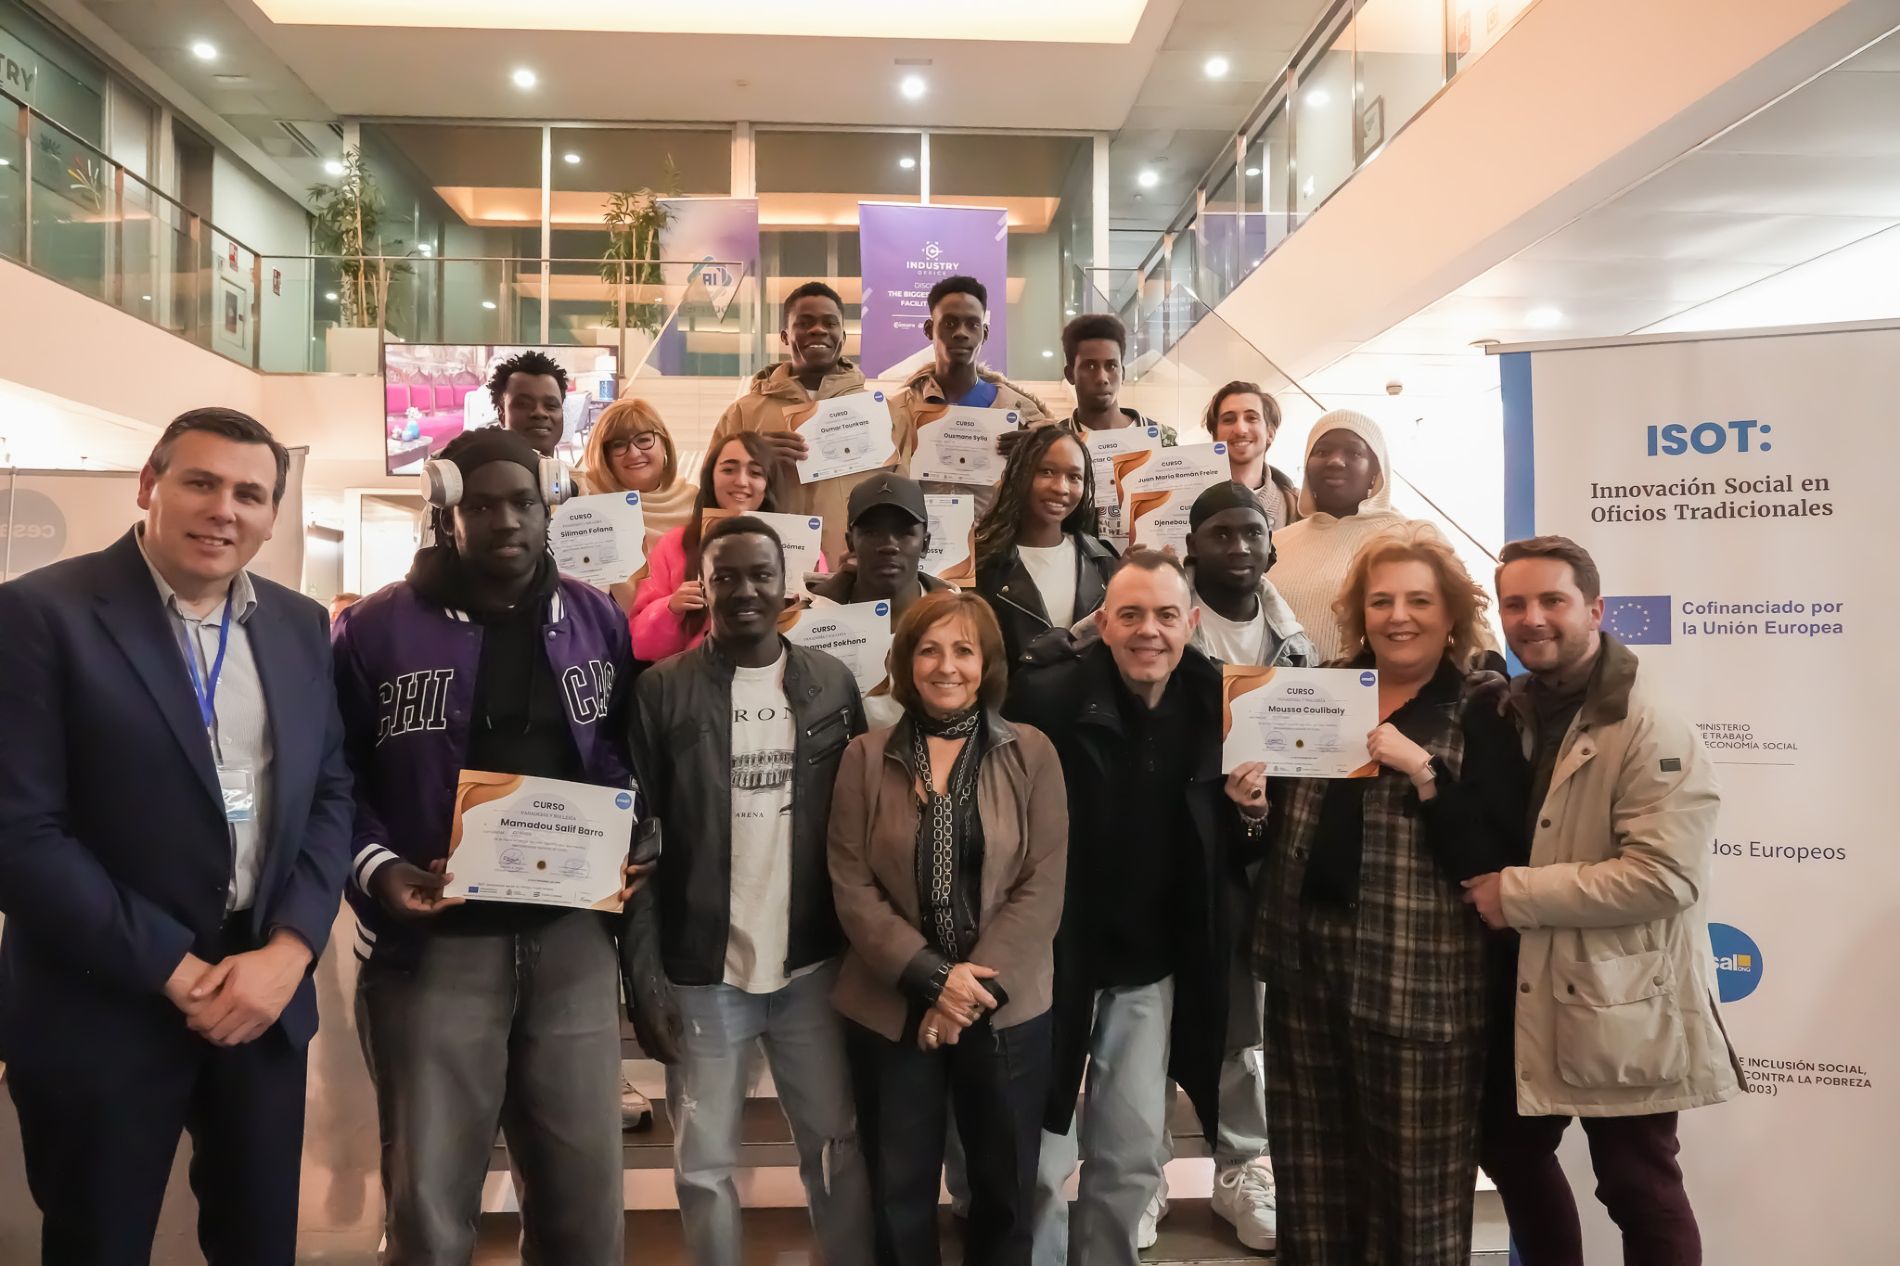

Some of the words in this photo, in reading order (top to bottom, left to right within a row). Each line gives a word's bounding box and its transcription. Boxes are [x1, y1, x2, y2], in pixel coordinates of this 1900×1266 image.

[906, 261, 959, 270] INDUSTRY
[829, 410, 848, 418] CURSO
[1647, 419, 1772, 456] ISOT:
[1591, 477, 1716, 499] Innovación
[1724, 475, 1793, 495] Social
[1801, 478, 1830, 492] en
[1591, 504, 1667, 523] Oficios
[1674, 499, 1833, 521] Tradicionales
[1682, 600, 1805, 615] Cofinanciado
[1811, 602, 1844, 617] por
[812, 624, 837, 634] CURSO
[1682, 621, 1697, 635] la
[1703, 620, 1758, 635] Unión
[1764, 621, 1843, 637] Europea
[1268, 705, 1302, 713] Moussa
[1303, 706, 1345, 716] Coulibaly
[1710, 733, 1753, 741] TRABAJO
[1704, 740, 1760, 749] ECONOMÍA
[1763, 742, 1798, 750] SOCIAL
[533, 800, 565, 811] CURSO
[500, 818, 553, 831] Mamadou
[554, 823, 577, 832] Salif
[578, 827, 604, 837] Barro
[1750, 841, 1846, 863] Europeos
[1748, 1058, 1815, 1071] INCLUSIÓN
[1818, 1063, 1867, 1075] SOCIAL,
[1798, 1075, 1812, 1084] LA
[1816, 1076, 1872, 1088] POBREZA
